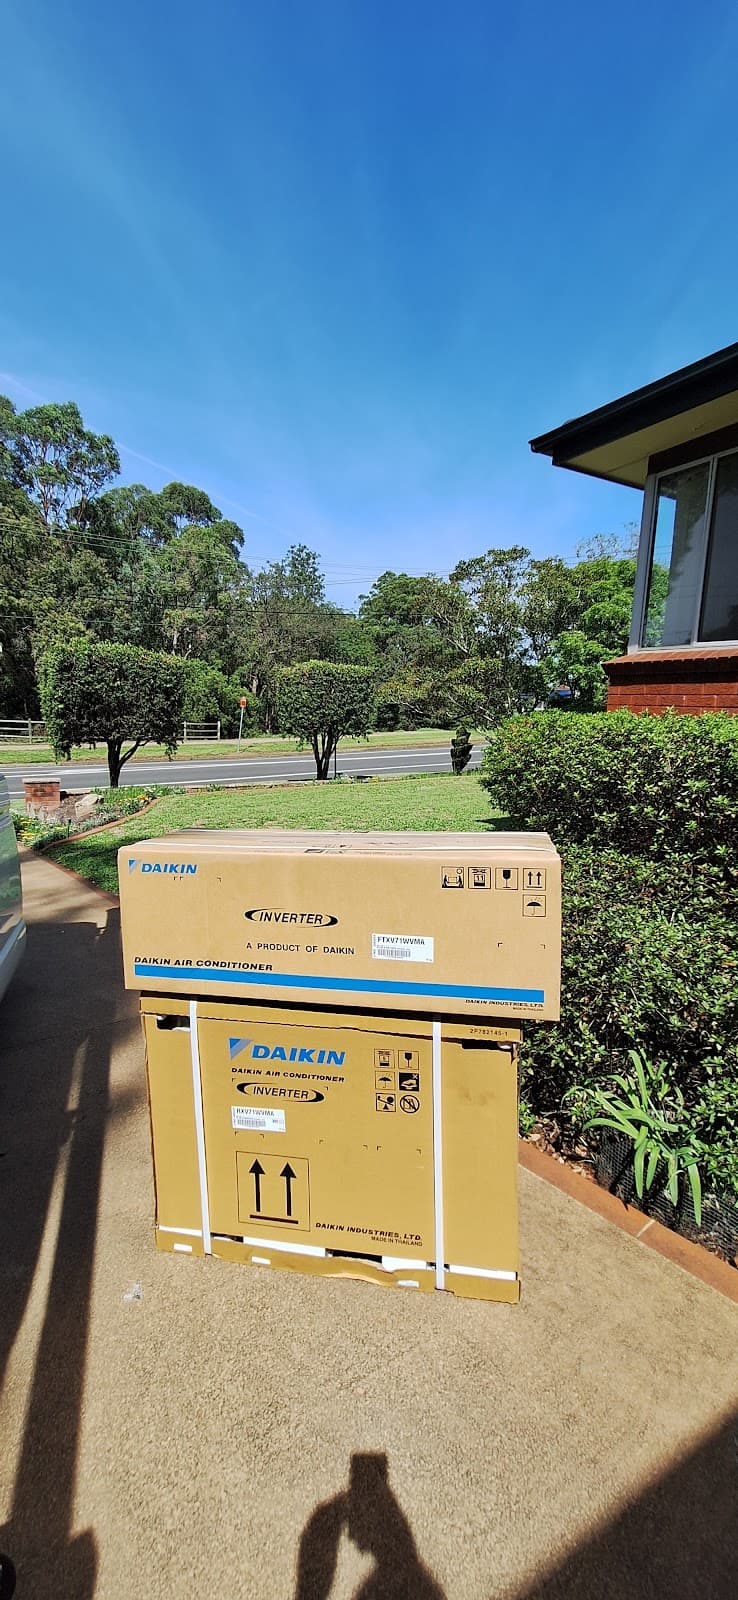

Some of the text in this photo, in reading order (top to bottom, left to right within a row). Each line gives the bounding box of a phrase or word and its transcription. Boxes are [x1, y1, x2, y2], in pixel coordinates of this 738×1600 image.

[141, 863, 197, 874] DAIKIN
[259, 911, 323, 925] INVERTER
[377, 936, 425, 945] FTXV71WVMA
[257, 942, 301, 952] PRODUCT
[305, 945, 318, 953] OF
[323, 946, 355, 955] DAIKIN
[134, 956, 273, 971] DAIKIN AIR CONDITIONER
[251, 1044, 346, 1066] DAIKIN
[231, 1067, 262, 1075] DAIKIN
[283, 1071, 345, 1083] CONDITIONER
[253, 1086, 309, 1099] INVERTER
[315, 1222, 345, 1232] DAIKIN
[346, 1226, 402, 1239] INDUSTRIES,
[371, 1235, 387, 1243] MADE
[395, 1239, 423, 1247] THAILAND
